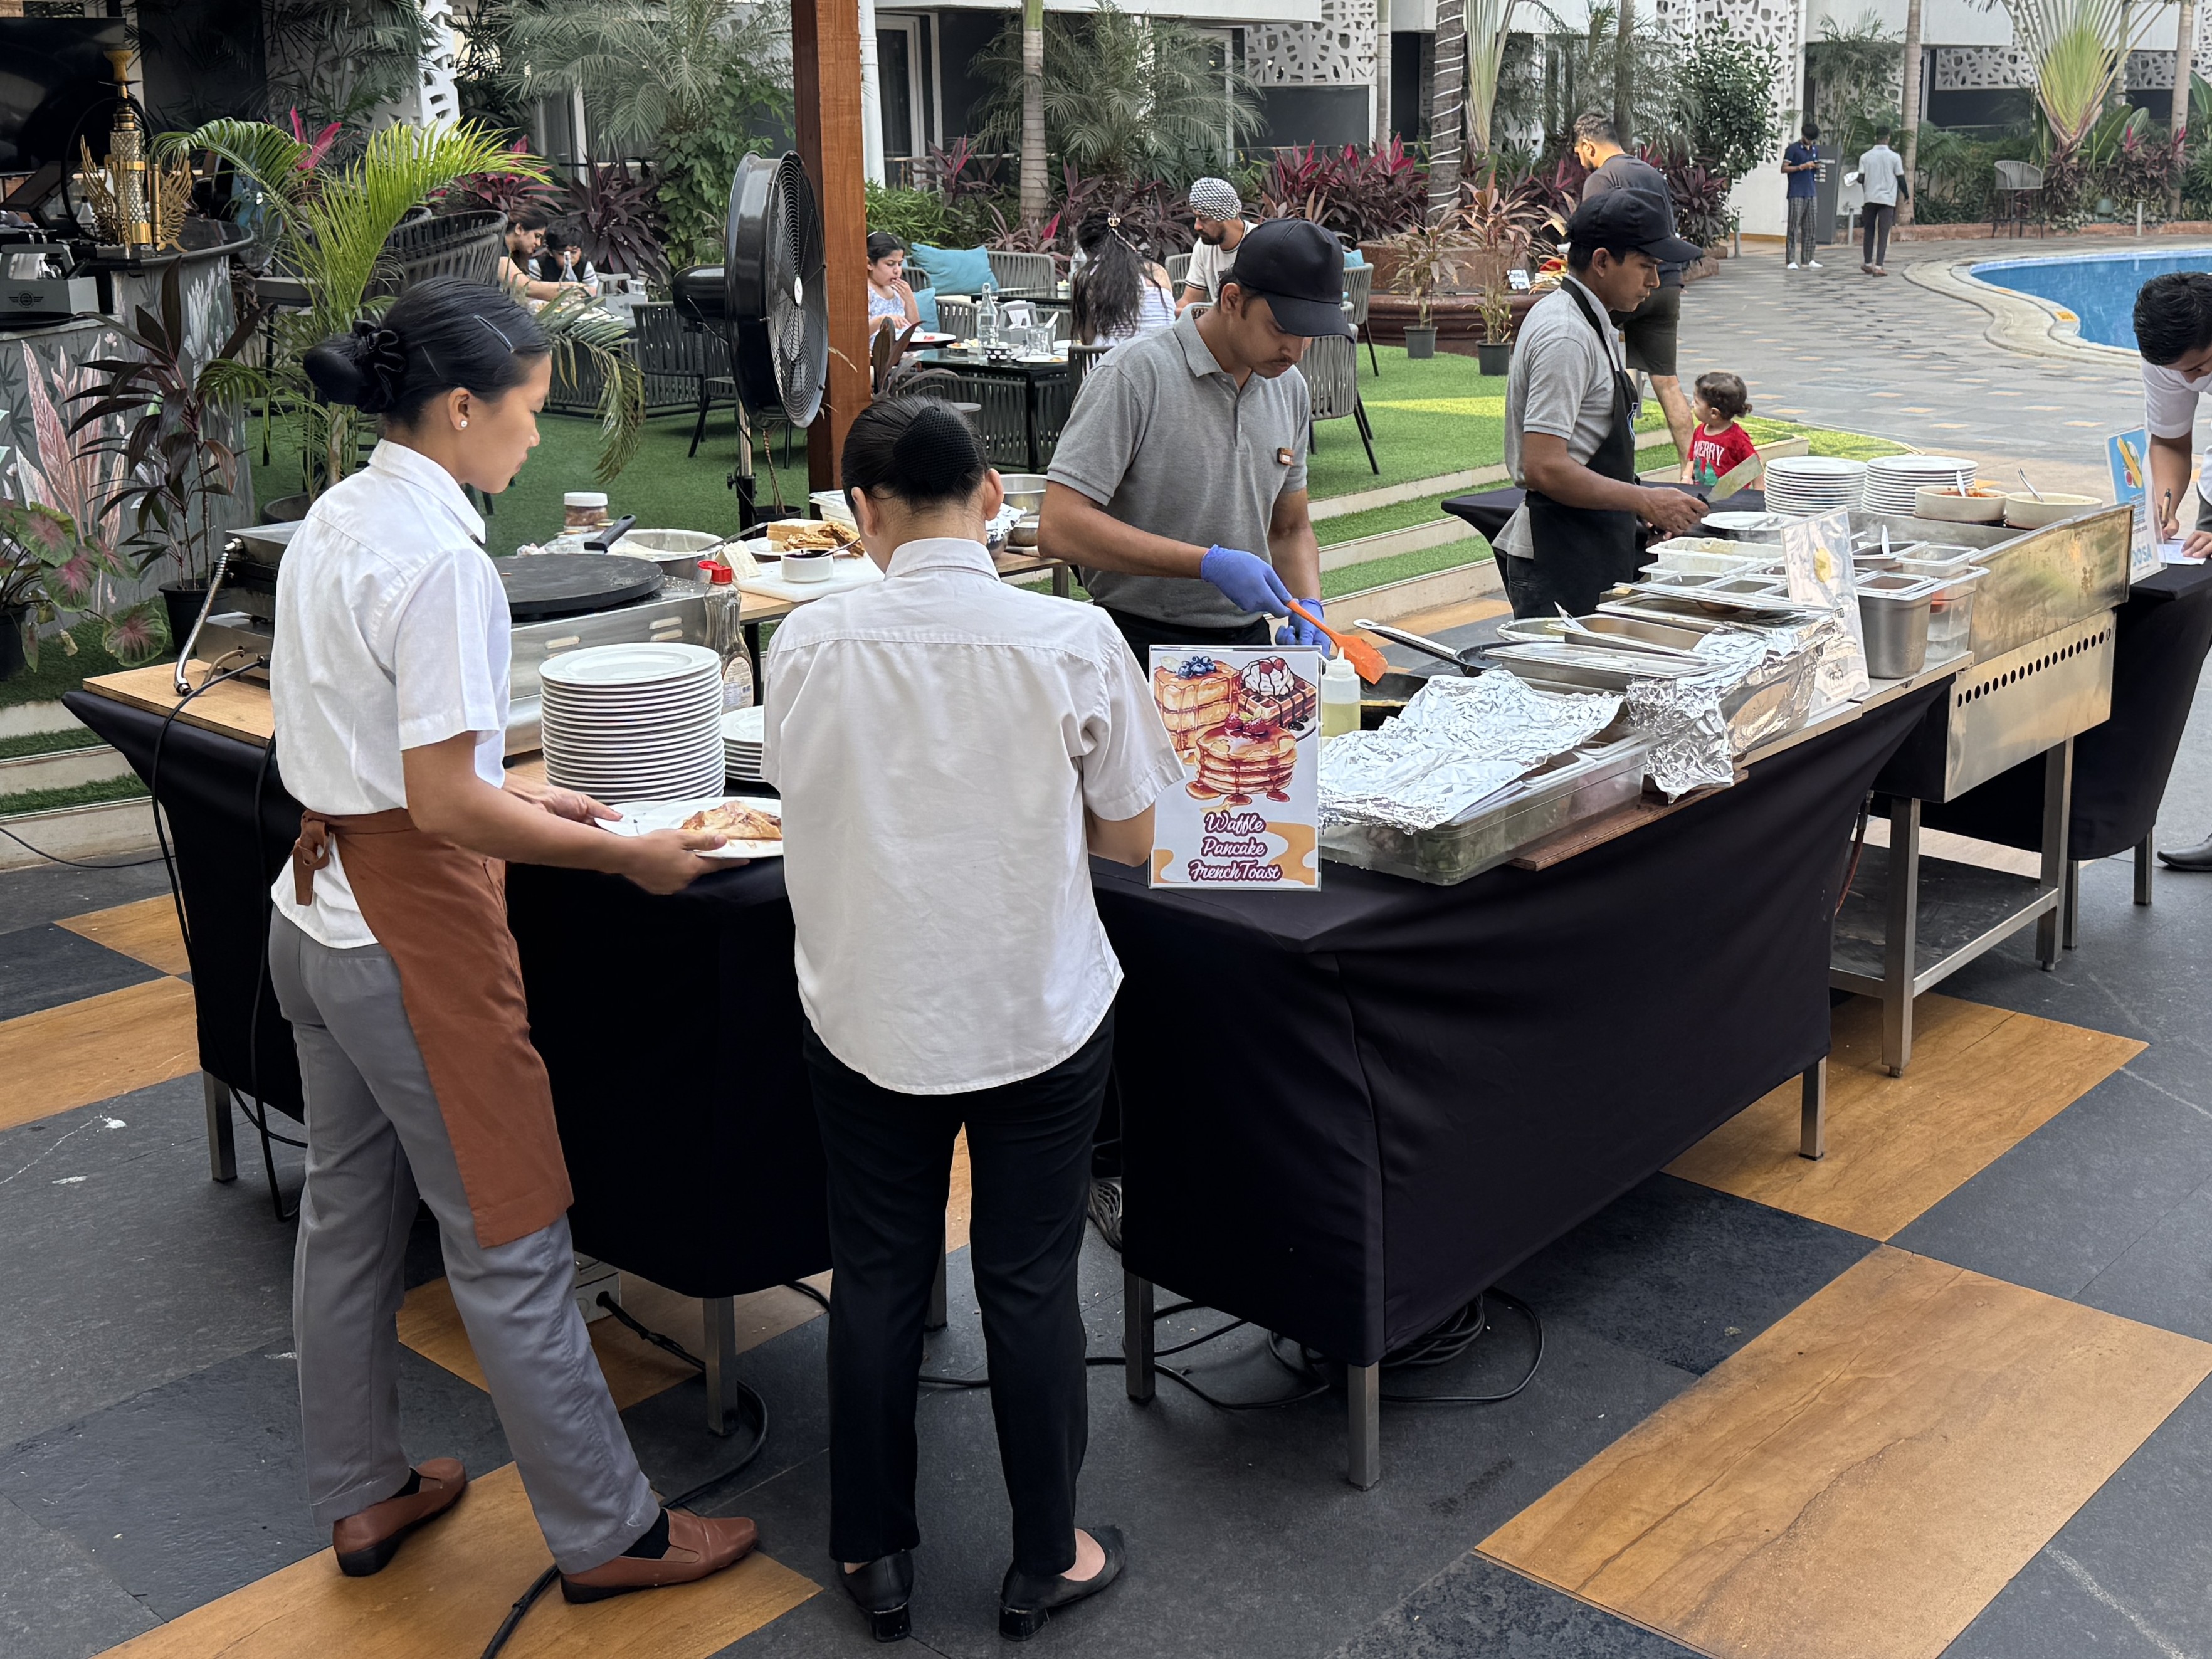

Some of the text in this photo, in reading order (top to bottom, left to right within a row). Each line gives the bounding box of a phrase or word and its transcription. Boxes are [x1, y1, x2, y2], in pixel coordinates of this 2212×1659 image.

[1693, 440, 1725, 466] MERRY
[1204, 811, 1265, 835] Waffle
[1202, 838, 1267, 856] Pancake
[1189, 860, 1282, 880] French Toast
